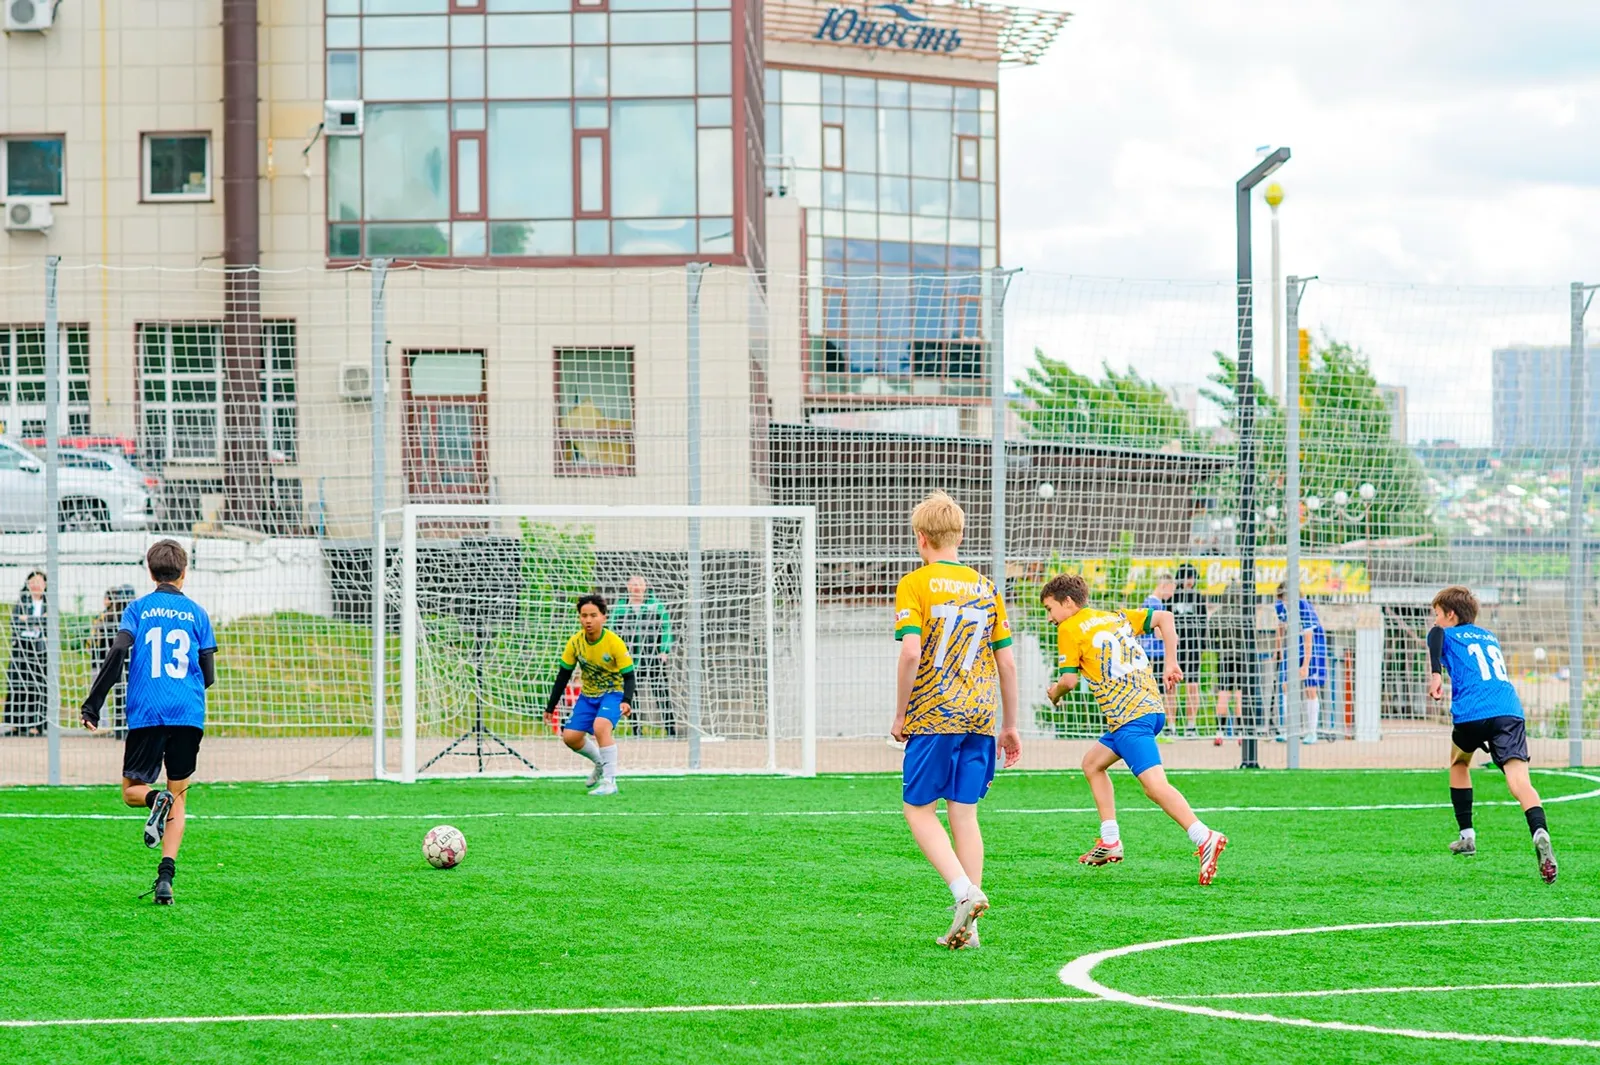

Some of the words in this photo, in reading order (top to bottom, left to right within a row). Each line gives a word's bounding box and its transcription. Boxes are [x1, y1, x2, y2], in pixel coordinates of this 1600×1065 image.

[813, 7, 963, 52] Юность
[145, 626, 191, 680] 13
[931, 604, 988, 672] 77
[1467, 642, 1509, 683] 18
